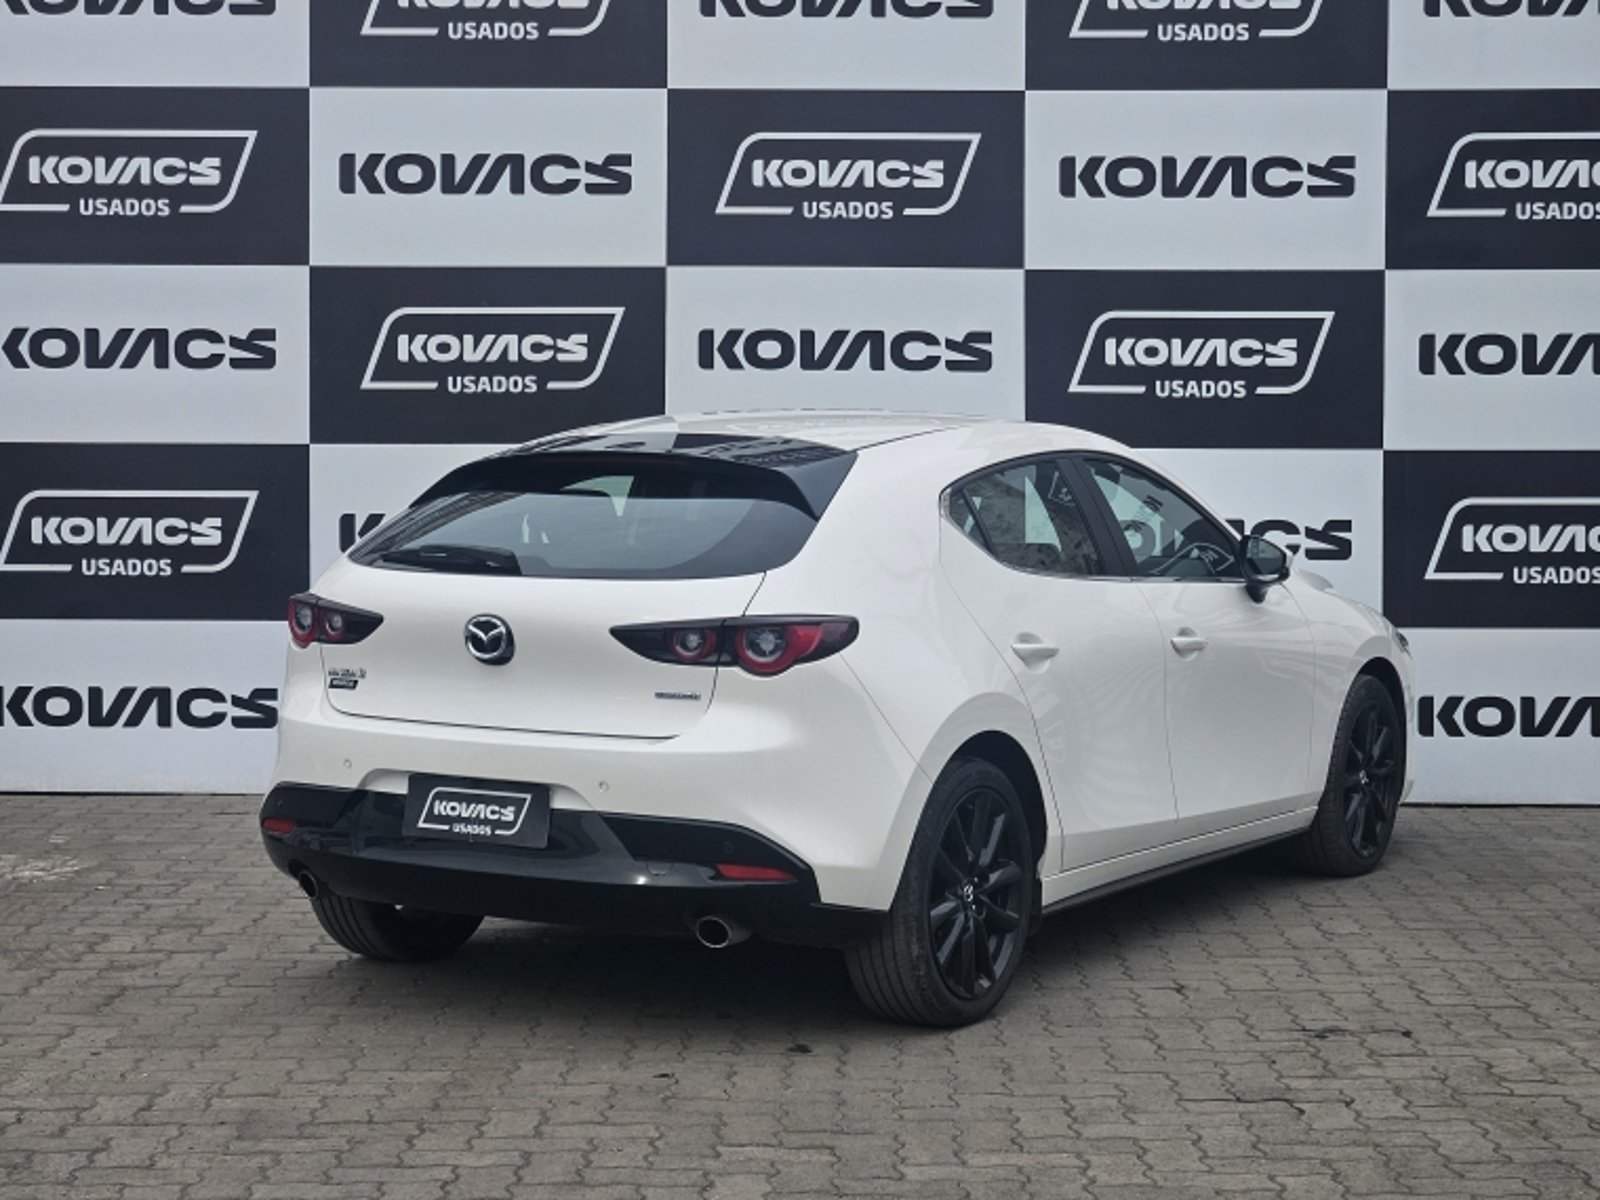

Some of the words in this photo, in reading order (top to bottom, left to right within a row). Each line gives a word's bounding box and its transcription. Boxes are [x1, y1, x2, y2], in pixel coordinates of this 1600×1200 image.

[448, 22, 539, 40] USADOS
[1157, 23, 1250, 41] USADOS
[28, 155, 221, 186] KOVACS
[339, 152, 633, 196] KOVACS
[752, 159, 944, 188] KOVACS
[1058, 155, 1356, 199] KOVACS
[1464, 159, 1600, 188] KOVA
[79, 198, 170, 217] USADOS
[803, 201, 894, 220] USADOS
[397, 333, 588, 363] KOVACS
[698, 328, 993, 373] KOVACS
[1104, 337, 1298, 367] KOVACS
[447, 375, 538, 393] USADOS
[1155, 380, 1247, 398] USADOS
[31, 516, 222, 546] KOVACS
[81, 558, 172, 576] USADOS
[0, 685, 278, 729] KOVACS
[433, 799, 516, 822] KOVACS
